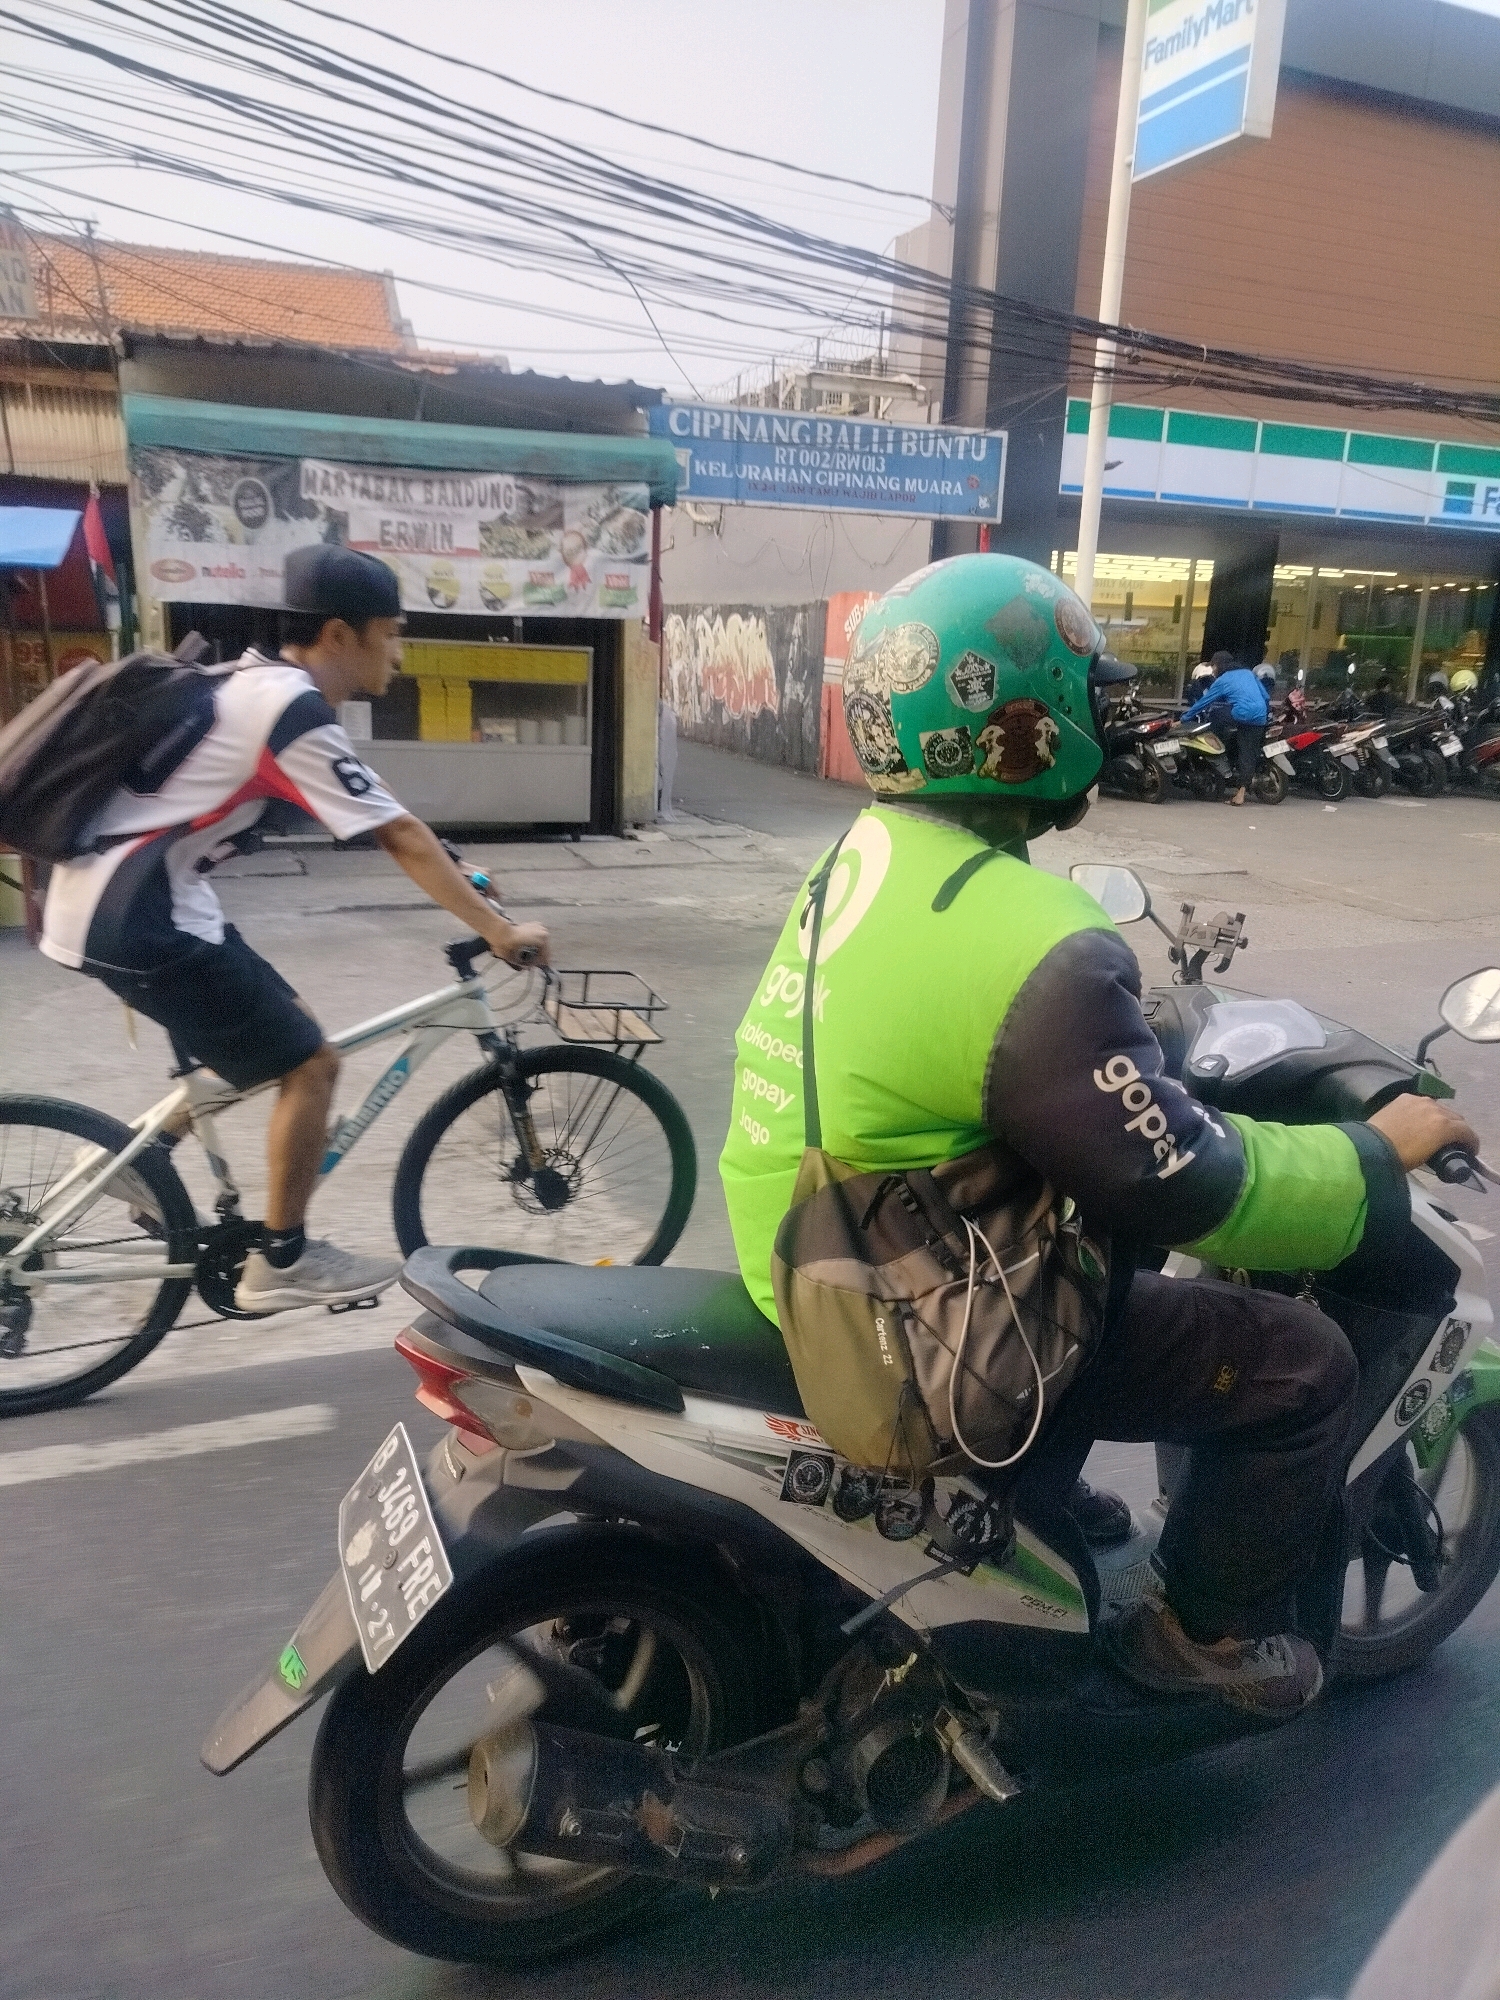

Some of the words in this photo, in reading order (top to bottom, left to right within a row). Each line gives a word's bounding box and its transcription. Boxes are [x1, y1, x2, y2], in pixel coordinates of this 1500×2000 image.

[669, 407, 811, 444] CIPINANG
[901, 430, 988, 462] BUNTU
[775, 446, 796, 466] RT
[424, 477, 515, 510] BANDUNG
[695, 459, 812, 485] KELURAHAN
[816, 471, 901, 492] CIPINANG
[905, 478, 963, 497] MUARA
[378, 518, 454, 552] ERWIN
[741, 1067, 796, 1113] gopay
[875, 1317, 888, 1352] Cartenz
[884, 1353, 894, 1365] 22
[373, 1436, 398, 1474] B
[377, 1467, 420, 1547] 3469
[397, 1535, 443, 1621] FRE
